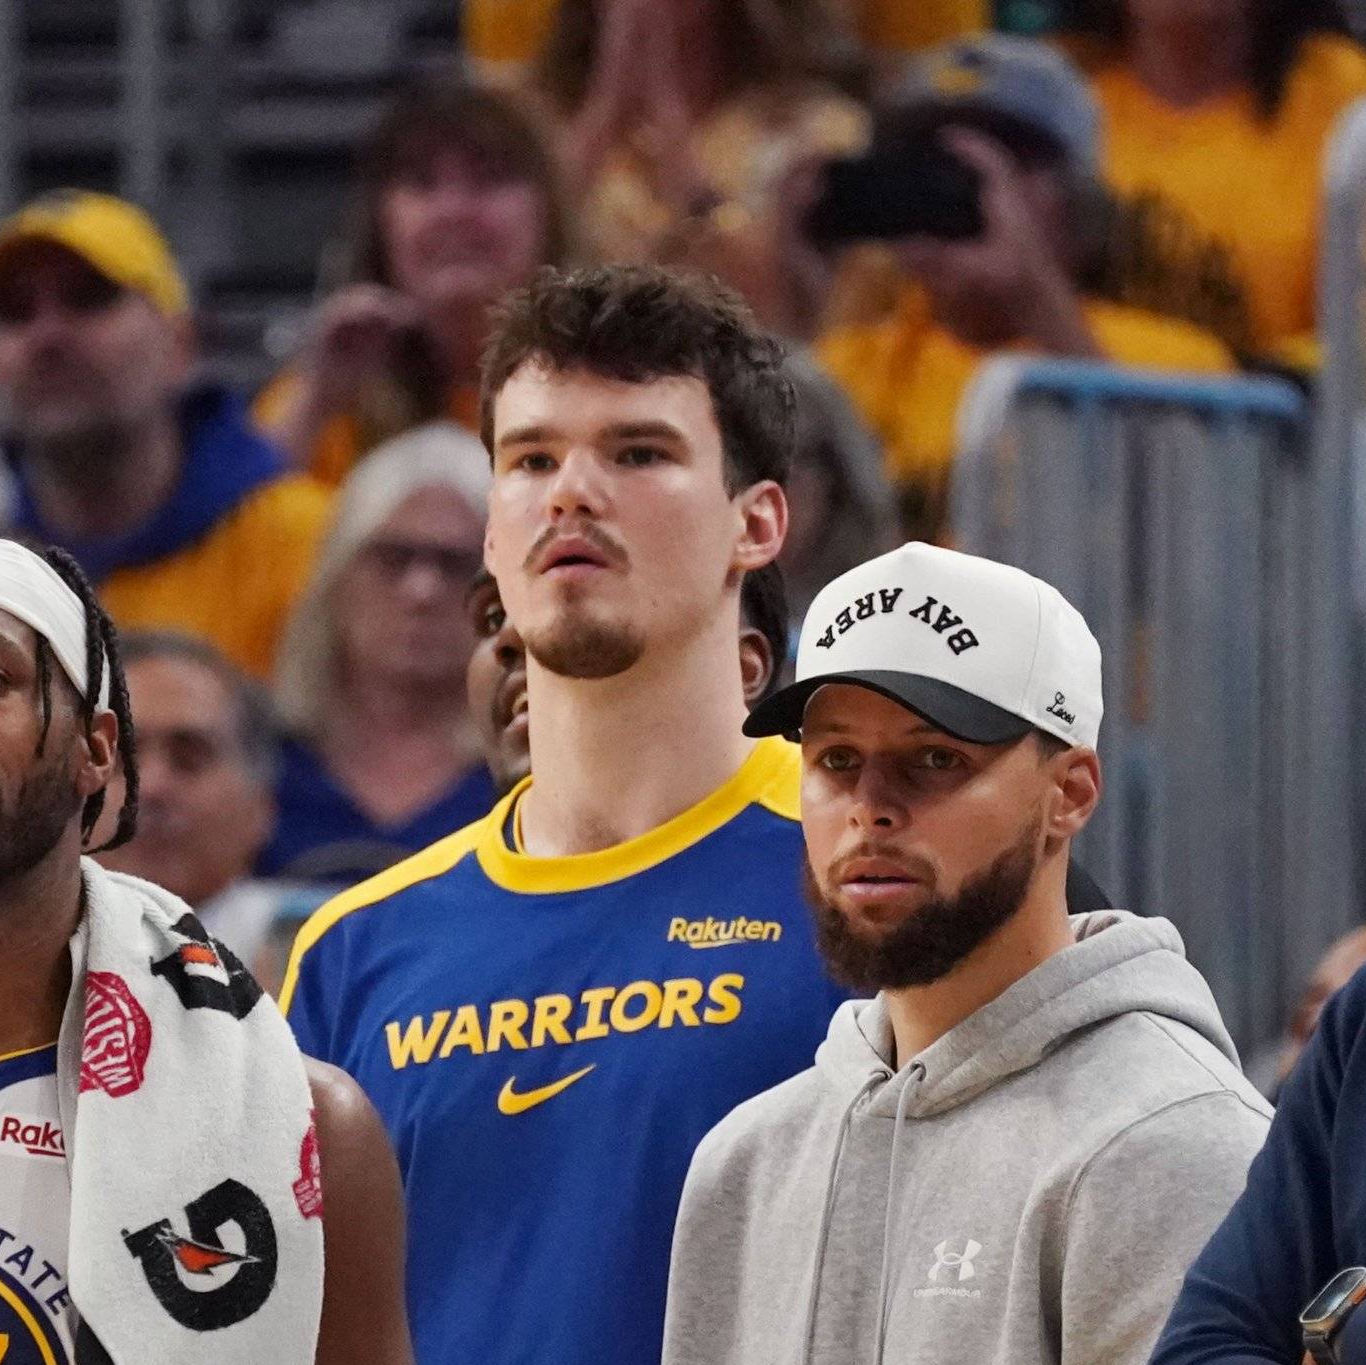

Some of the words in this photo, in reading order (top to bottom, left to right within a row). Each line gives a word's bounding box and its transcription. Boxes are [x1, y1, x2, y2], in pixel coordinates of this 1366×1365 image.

[815, 587, 904, 650] AREA
[909, 595, 980, 656] BAY
[666, 915, 783, 946] Rakuten
[384, 972, 746, 1070] WARRIORS
